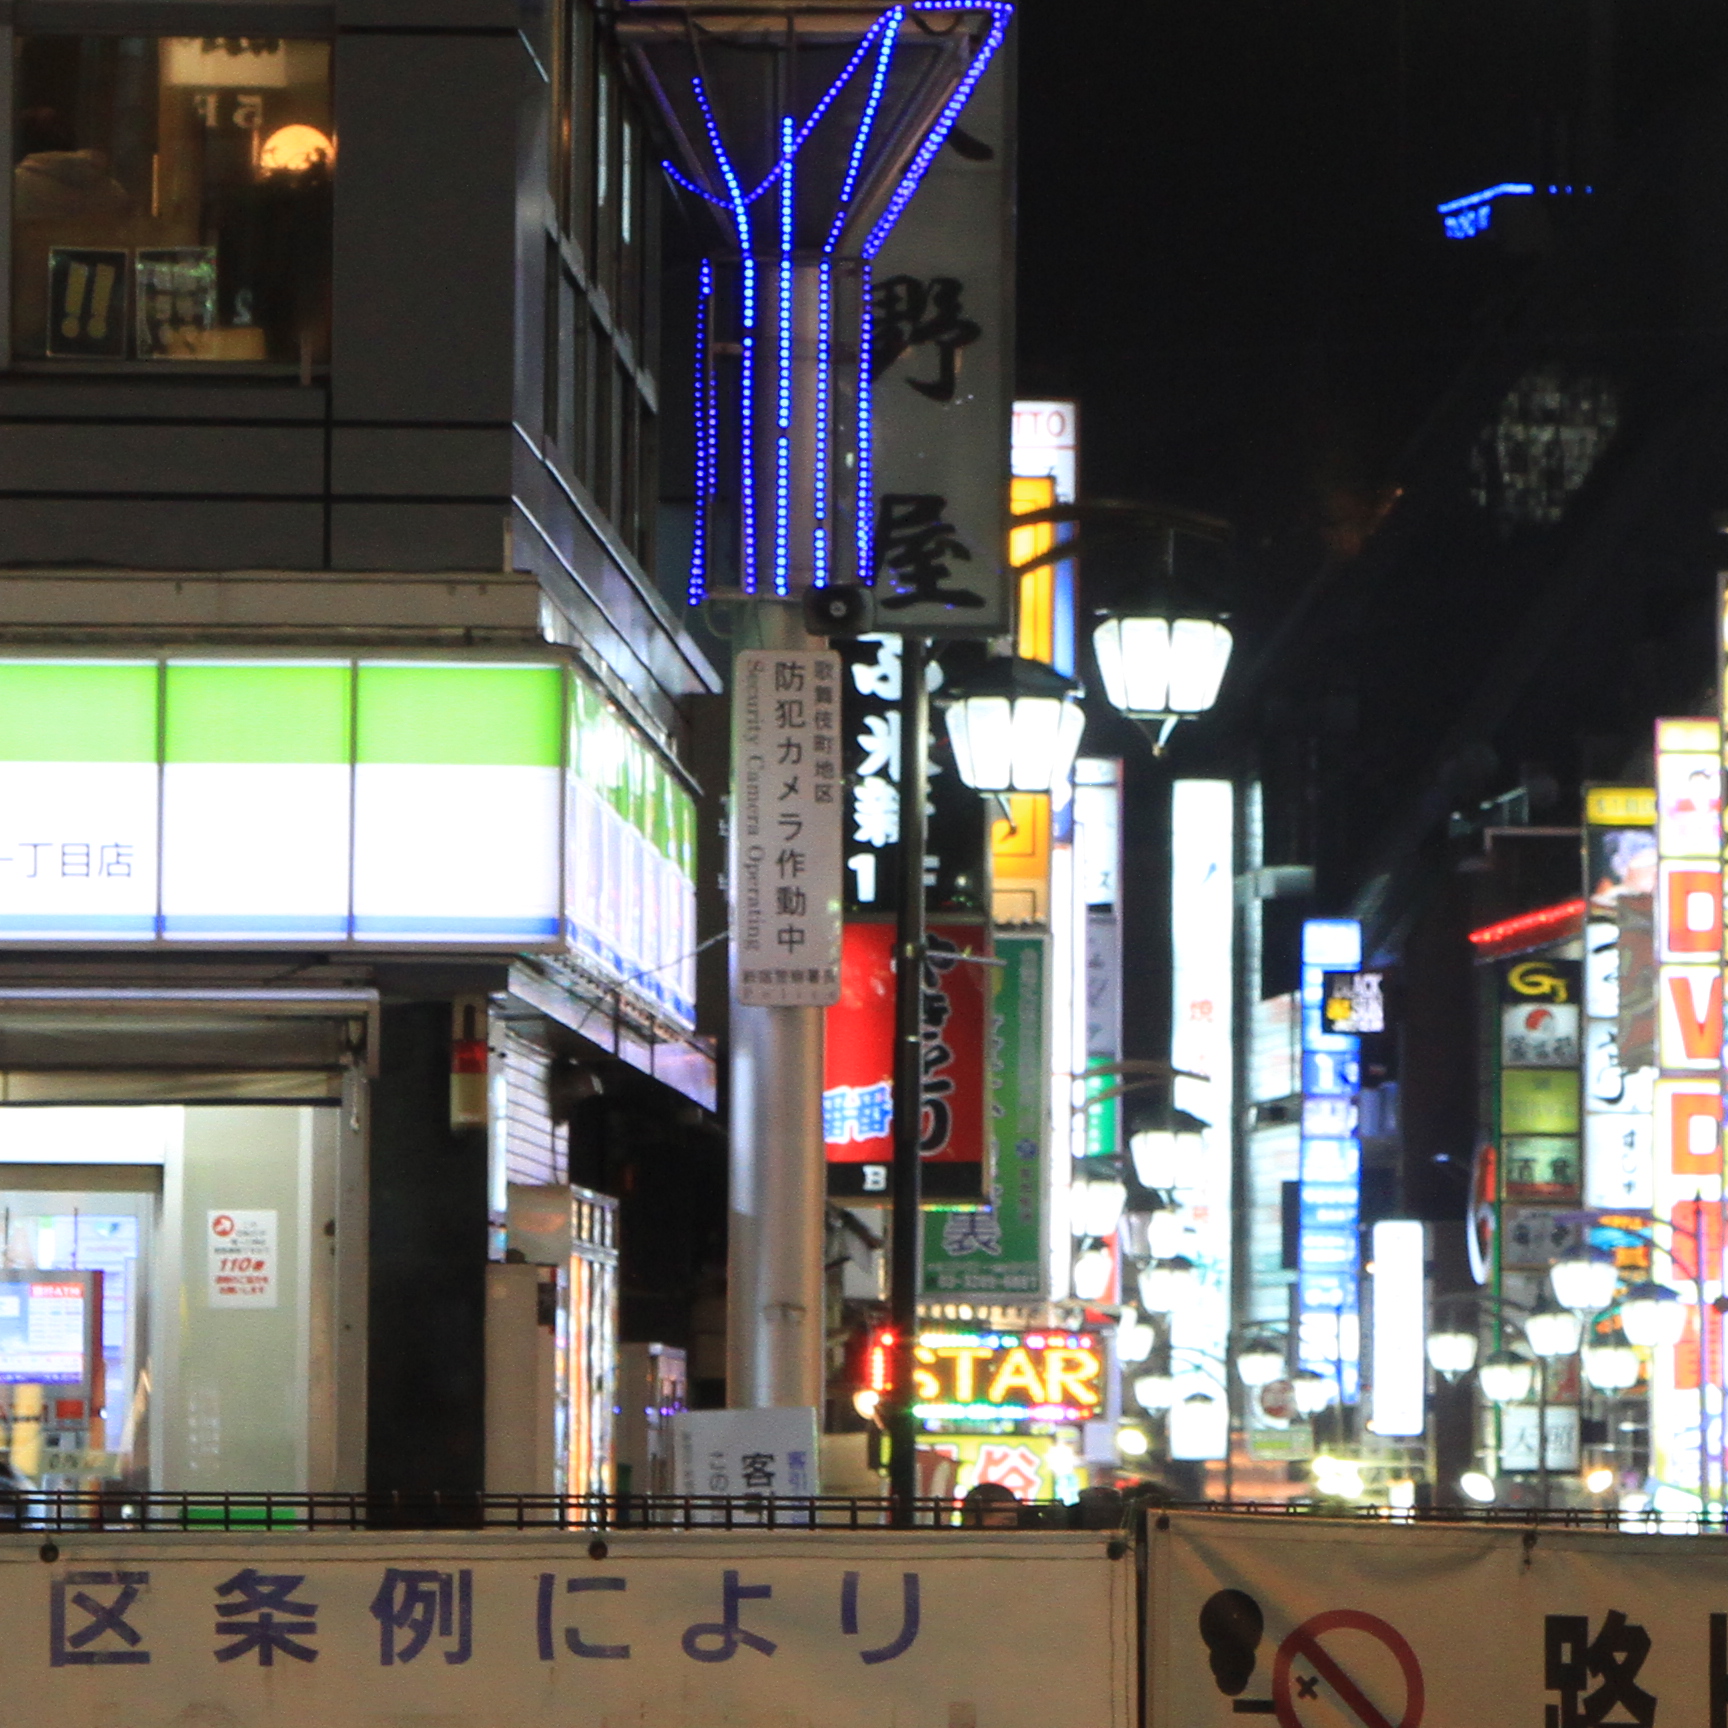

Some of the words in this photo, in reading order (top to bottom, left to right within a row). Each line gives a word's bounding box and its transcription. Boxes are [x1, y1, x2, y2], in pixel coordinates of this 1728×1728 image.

[744, 658, 766, 745] Security
[813, 659, 835, 805] 歌舞伎町地区
[745, 753, 765, 837] Camera
[774, 660, 807, 956] 防犯カメラ作動中
[744, 844, 766, 952] Operating
[1668, 871, 1723, 1176] DVD
[908, 1344, 1101, 1404] STAR
